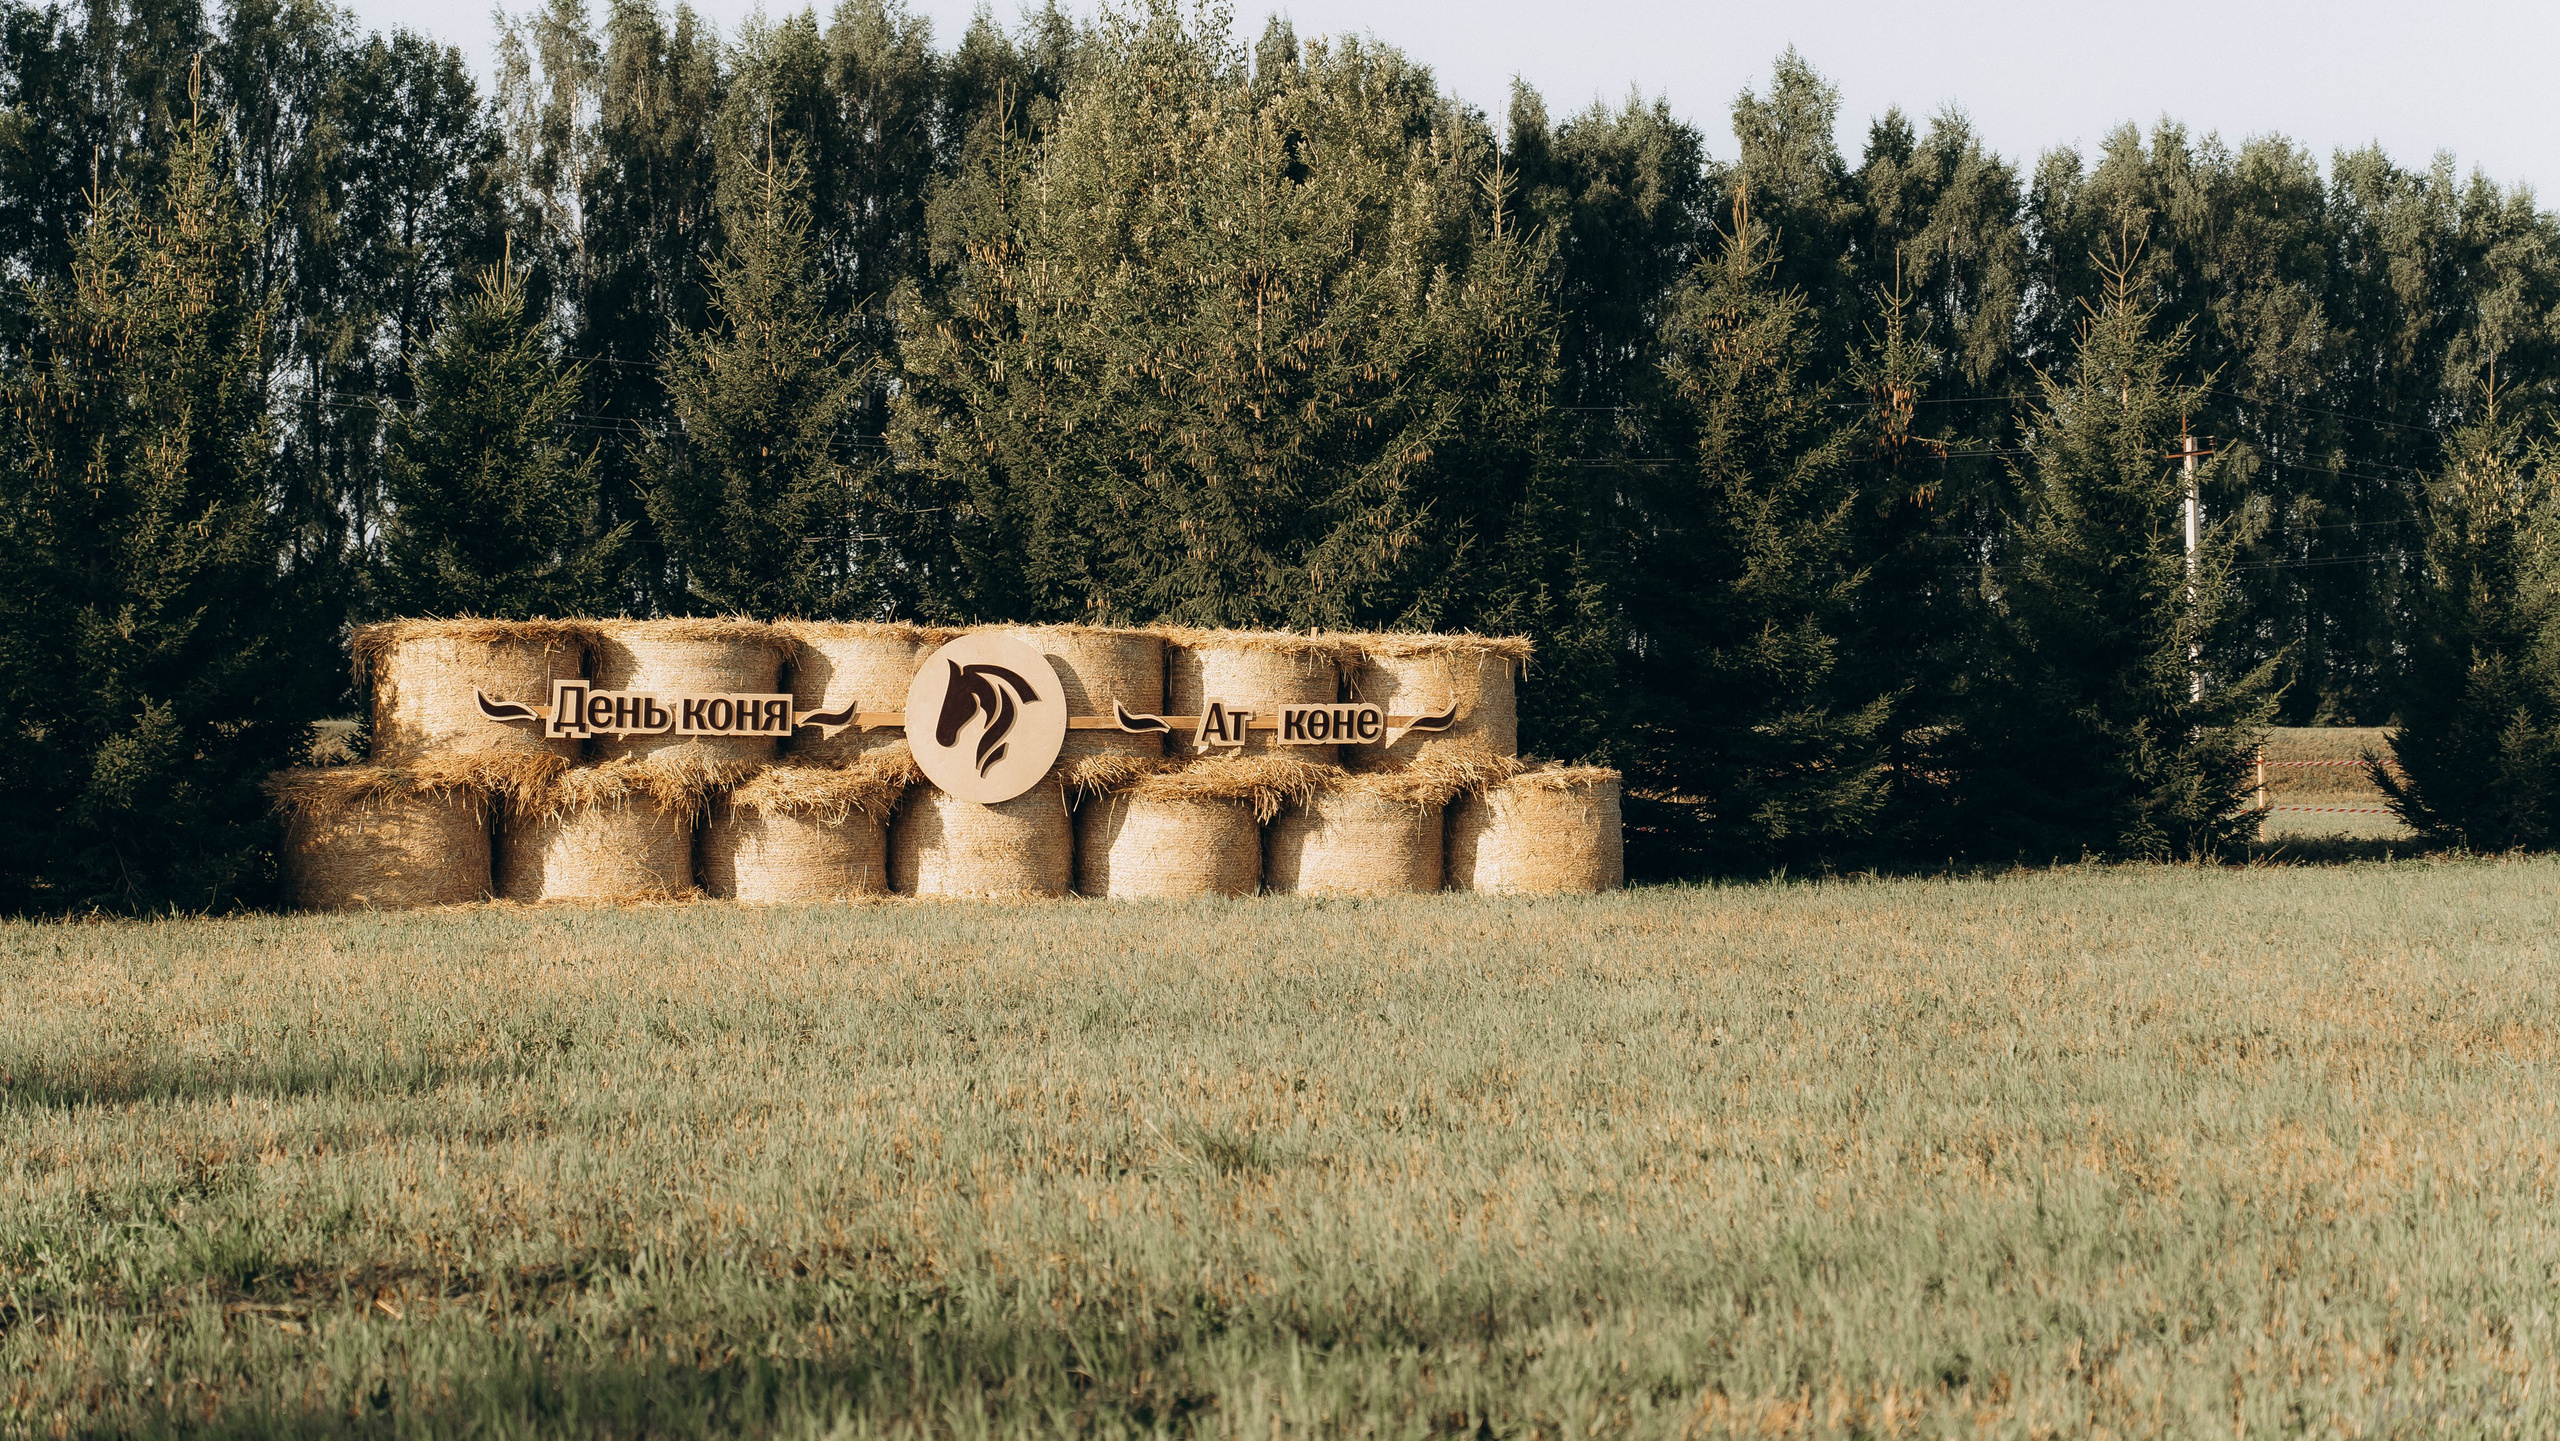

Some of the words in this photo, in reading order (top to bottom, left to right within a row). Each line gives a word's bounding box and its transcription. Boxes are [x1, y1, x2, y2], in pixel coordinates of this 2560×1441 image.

[554, 686, 669, 734] День
[683, 698, 790, 732] коня
[1201, 702, 1249, 742] Ат
[1284, 706, 1379, 740] көне
